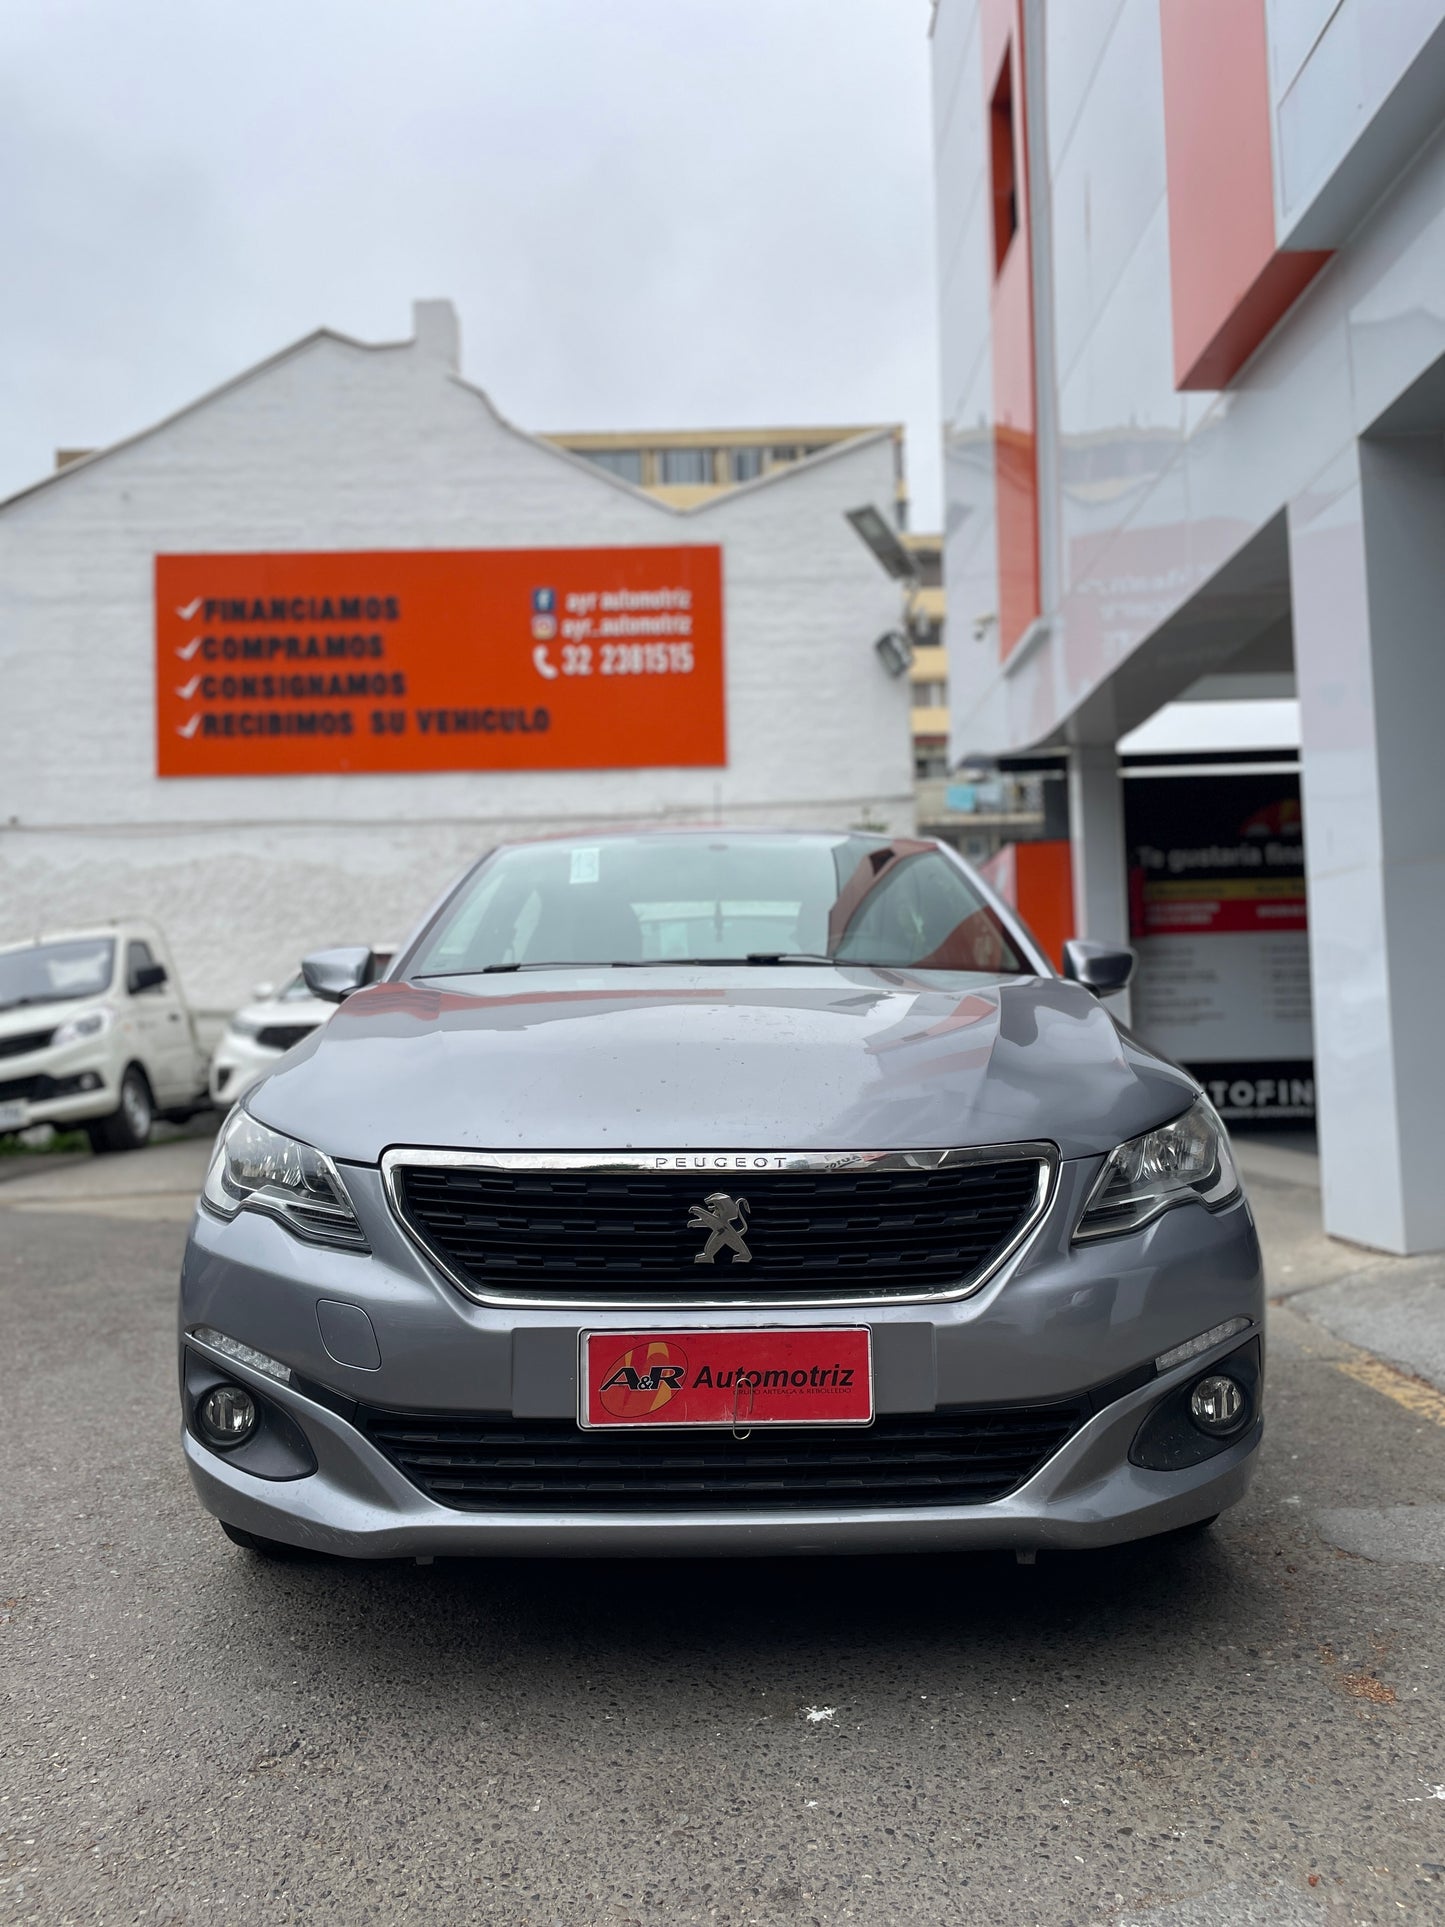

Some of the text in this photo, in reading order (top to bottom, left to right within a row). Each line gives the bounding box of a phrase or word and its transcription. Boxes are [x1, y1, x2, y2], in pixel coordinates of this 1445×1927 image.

[203, 596, 400, 623] FINANCIAMOS
[565, 592, 597, 616] ayr
[599, 587, 692, 611] automotriz
[202, 634, 383, 660] COMPRAMOS
[561, 643, 593, 676] 32
[202, 673, 406, 699] CONSIGNAMOS
[202, 707, 551, 737] RECIBIMOS SU VEHICULO
[1200, 1079, 1314, 1107] TOFIN
[655, 1157, 787, 1168] PEUGEOT
[599, 1363, 854, 1391] A&R Automotriz
